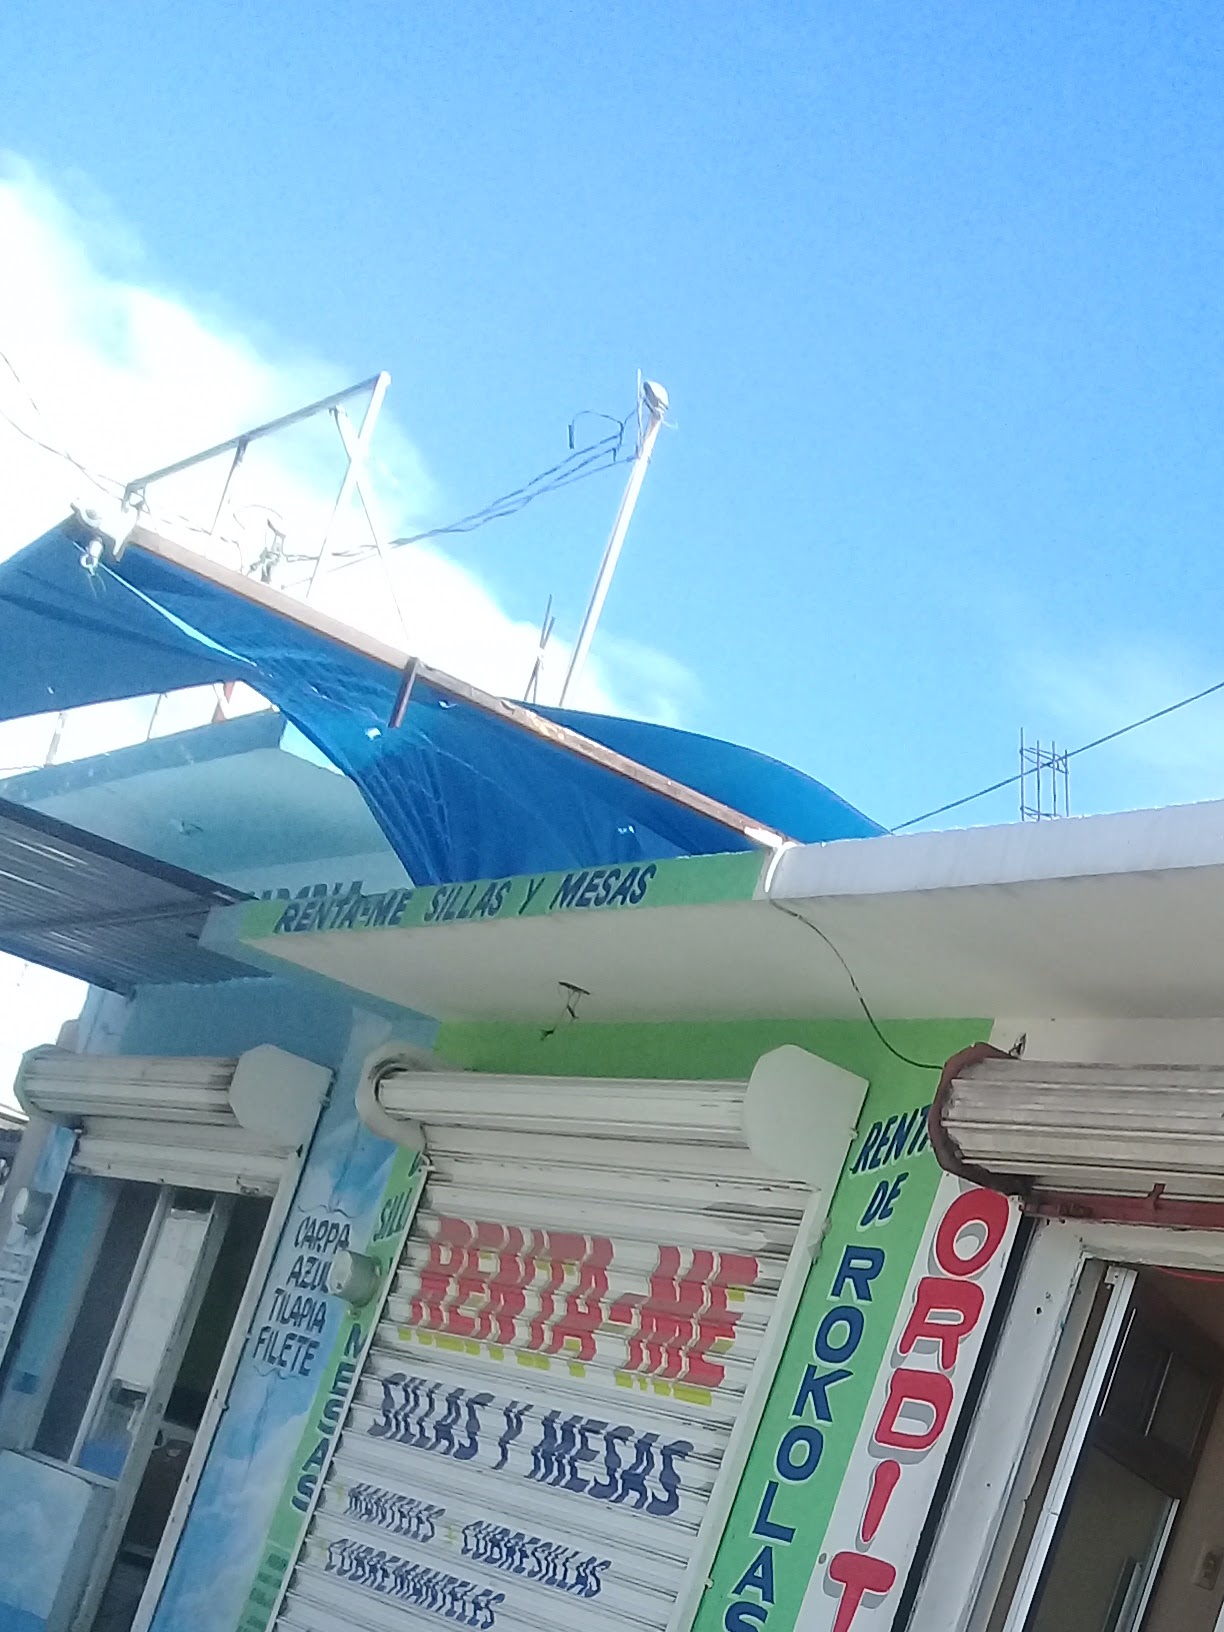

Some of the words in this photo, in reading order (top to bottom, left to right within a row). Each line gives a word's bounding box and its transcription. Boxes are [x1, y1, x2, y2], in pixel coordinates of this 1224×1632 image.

[274, 886, 412, 935] RENTA-ME
[424, 884, 513, 923] SILLAS
[517, 876, 546, 916] Y
[548, 863, 657, 911] MESAS
[848, 1103, 936, 1175] RENT
[294, 1214, 350, 1254] CARPA
[859, 1171, 910, 1227] DE
[286, 1254, 333, 1294] AZUL
[404, 1216, 759, 1390] RENTA-ME
[268, 1287, 327, 1334] TILAPIA
[251, 1325, 321, 1377] FILETE
[366, 1372, 497, 1461] SILLAS
[491, 1400, 535, 1470] Y
[524, 1410, 695, 1516] MESAS
[343, 1482, 447, 1543] MANTELES
[461, 1520, 612, 1599] CUBRESILLAS
[324, 1538, 507, 1631] CUBREMANTELES
